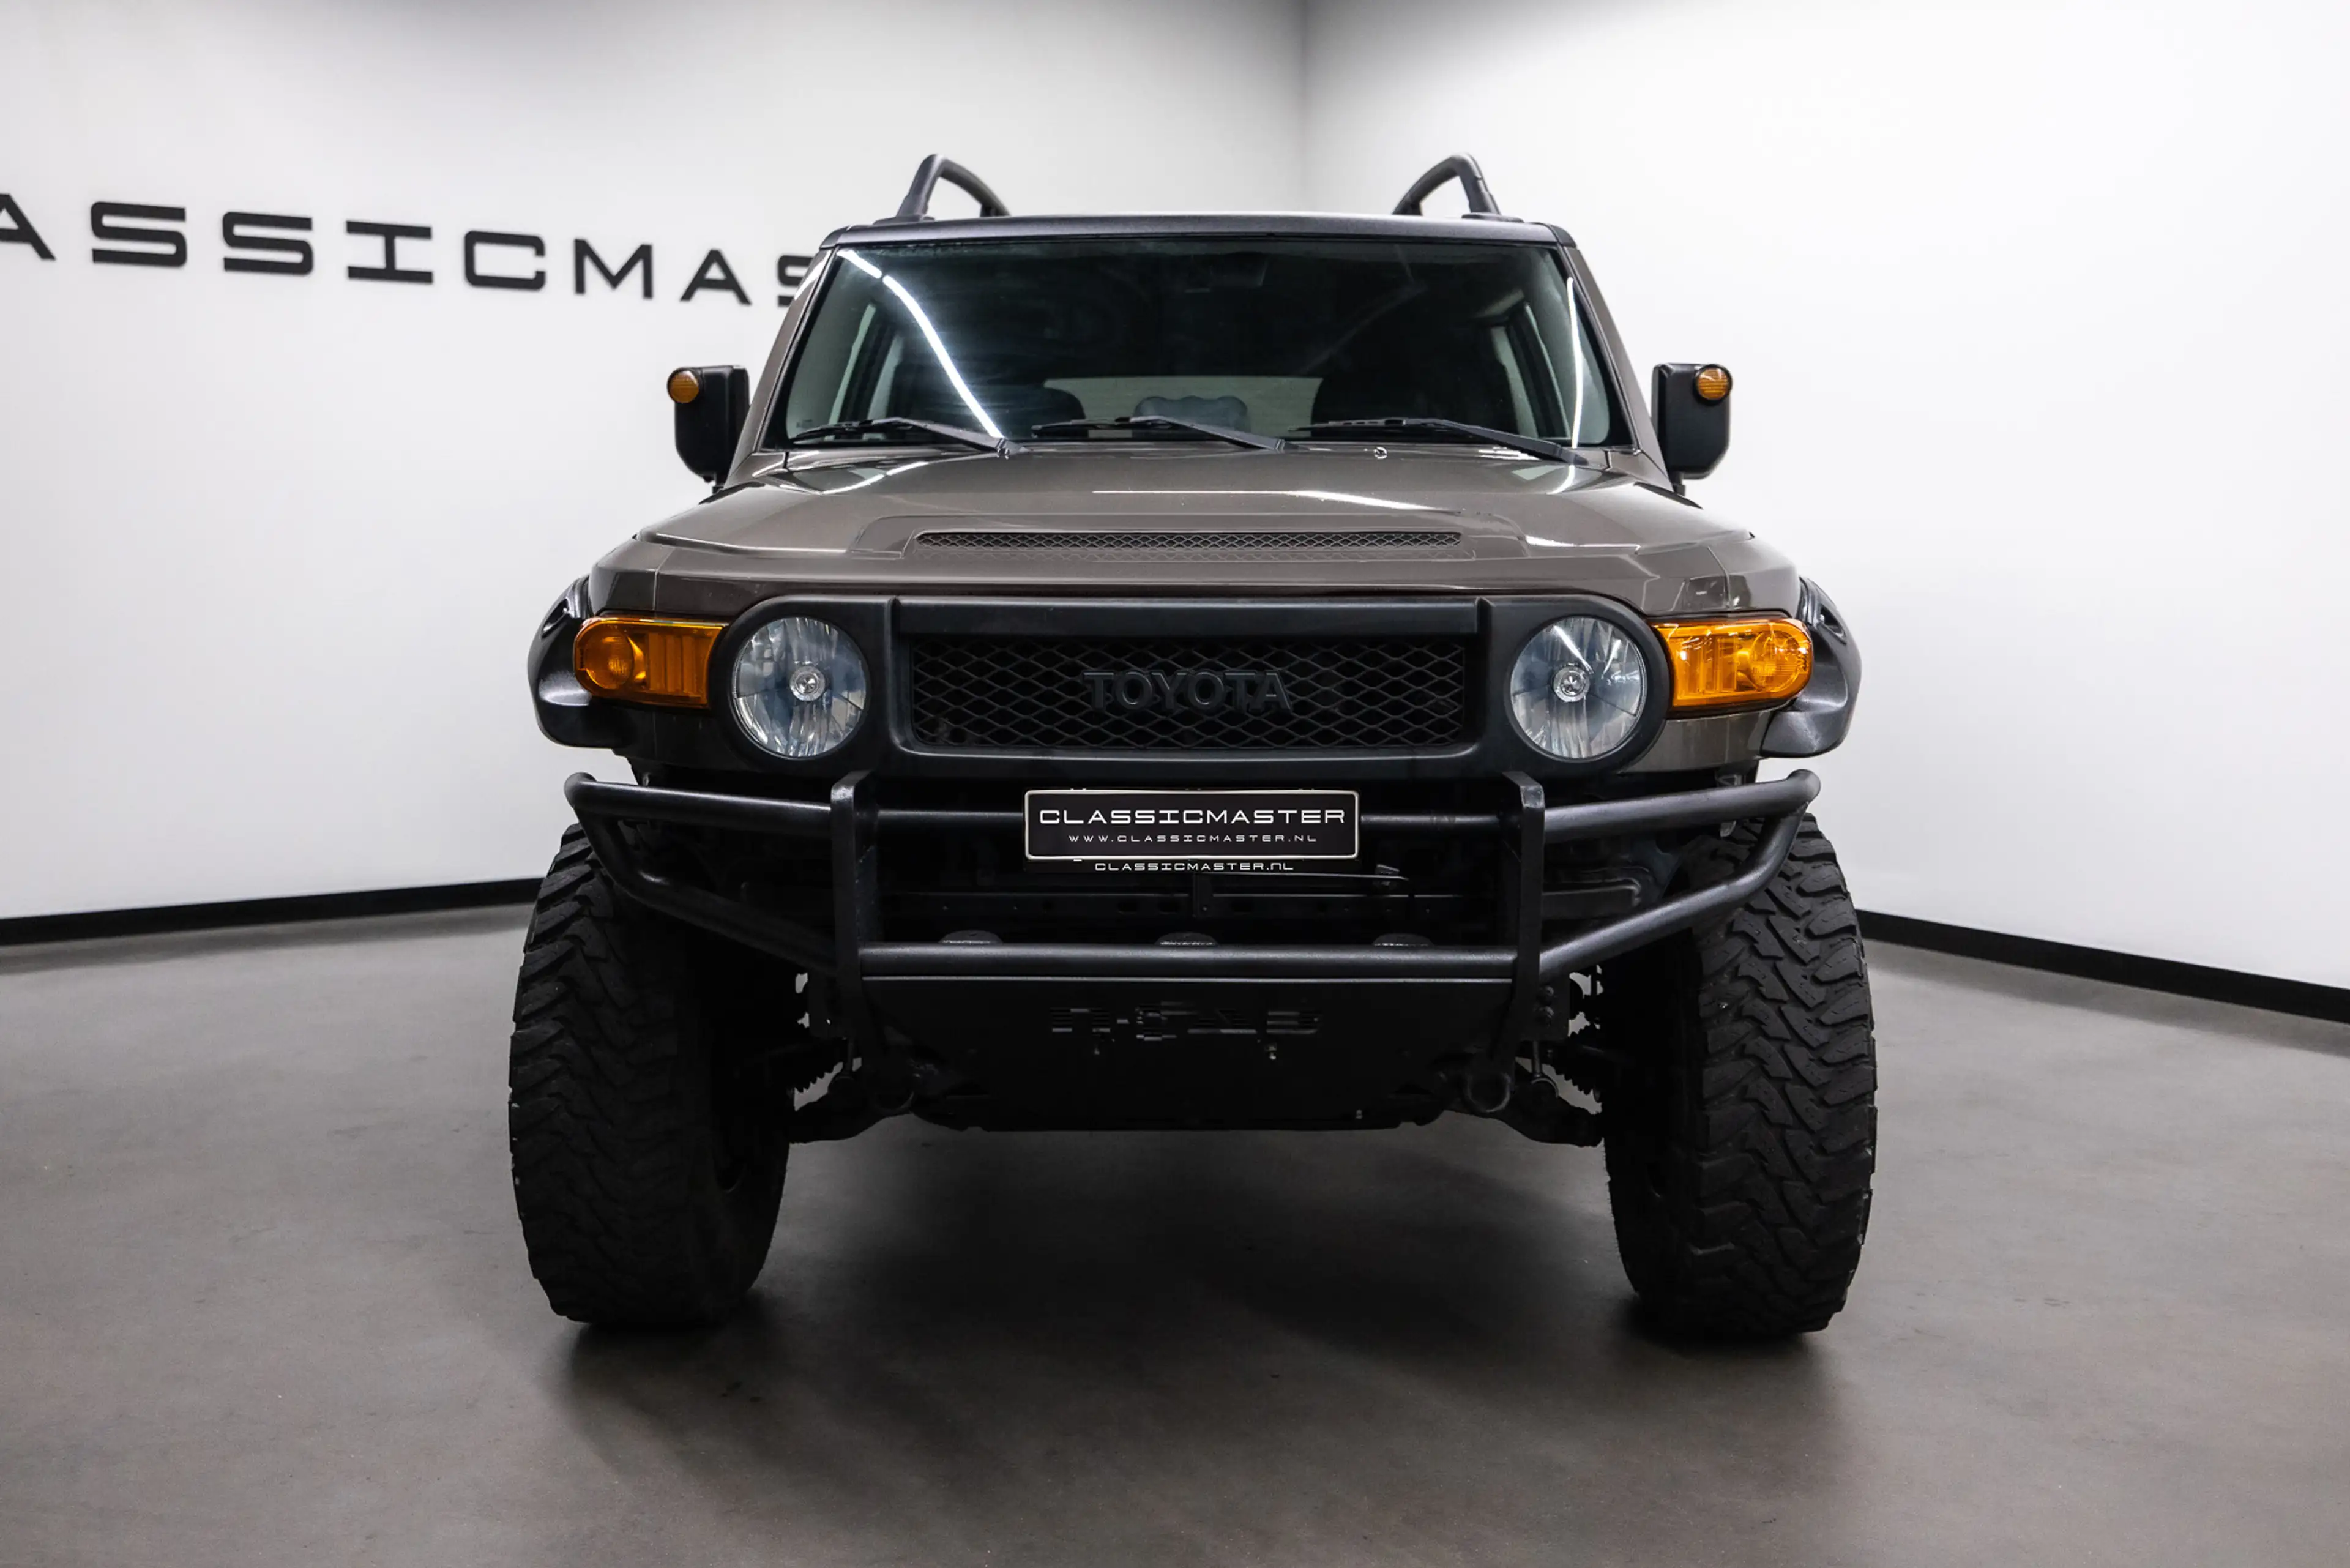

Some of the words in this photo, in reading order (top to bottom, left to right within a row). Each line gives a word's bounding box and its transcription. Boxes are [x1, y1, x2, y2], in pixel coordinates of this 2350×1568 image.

[1082, 671, 1292, 711] TOYOTA
[1040, 809, 1345, 824] CLASSICMASTER
[1094, 862, 1294, 871] CLASSICMASTER.NL
